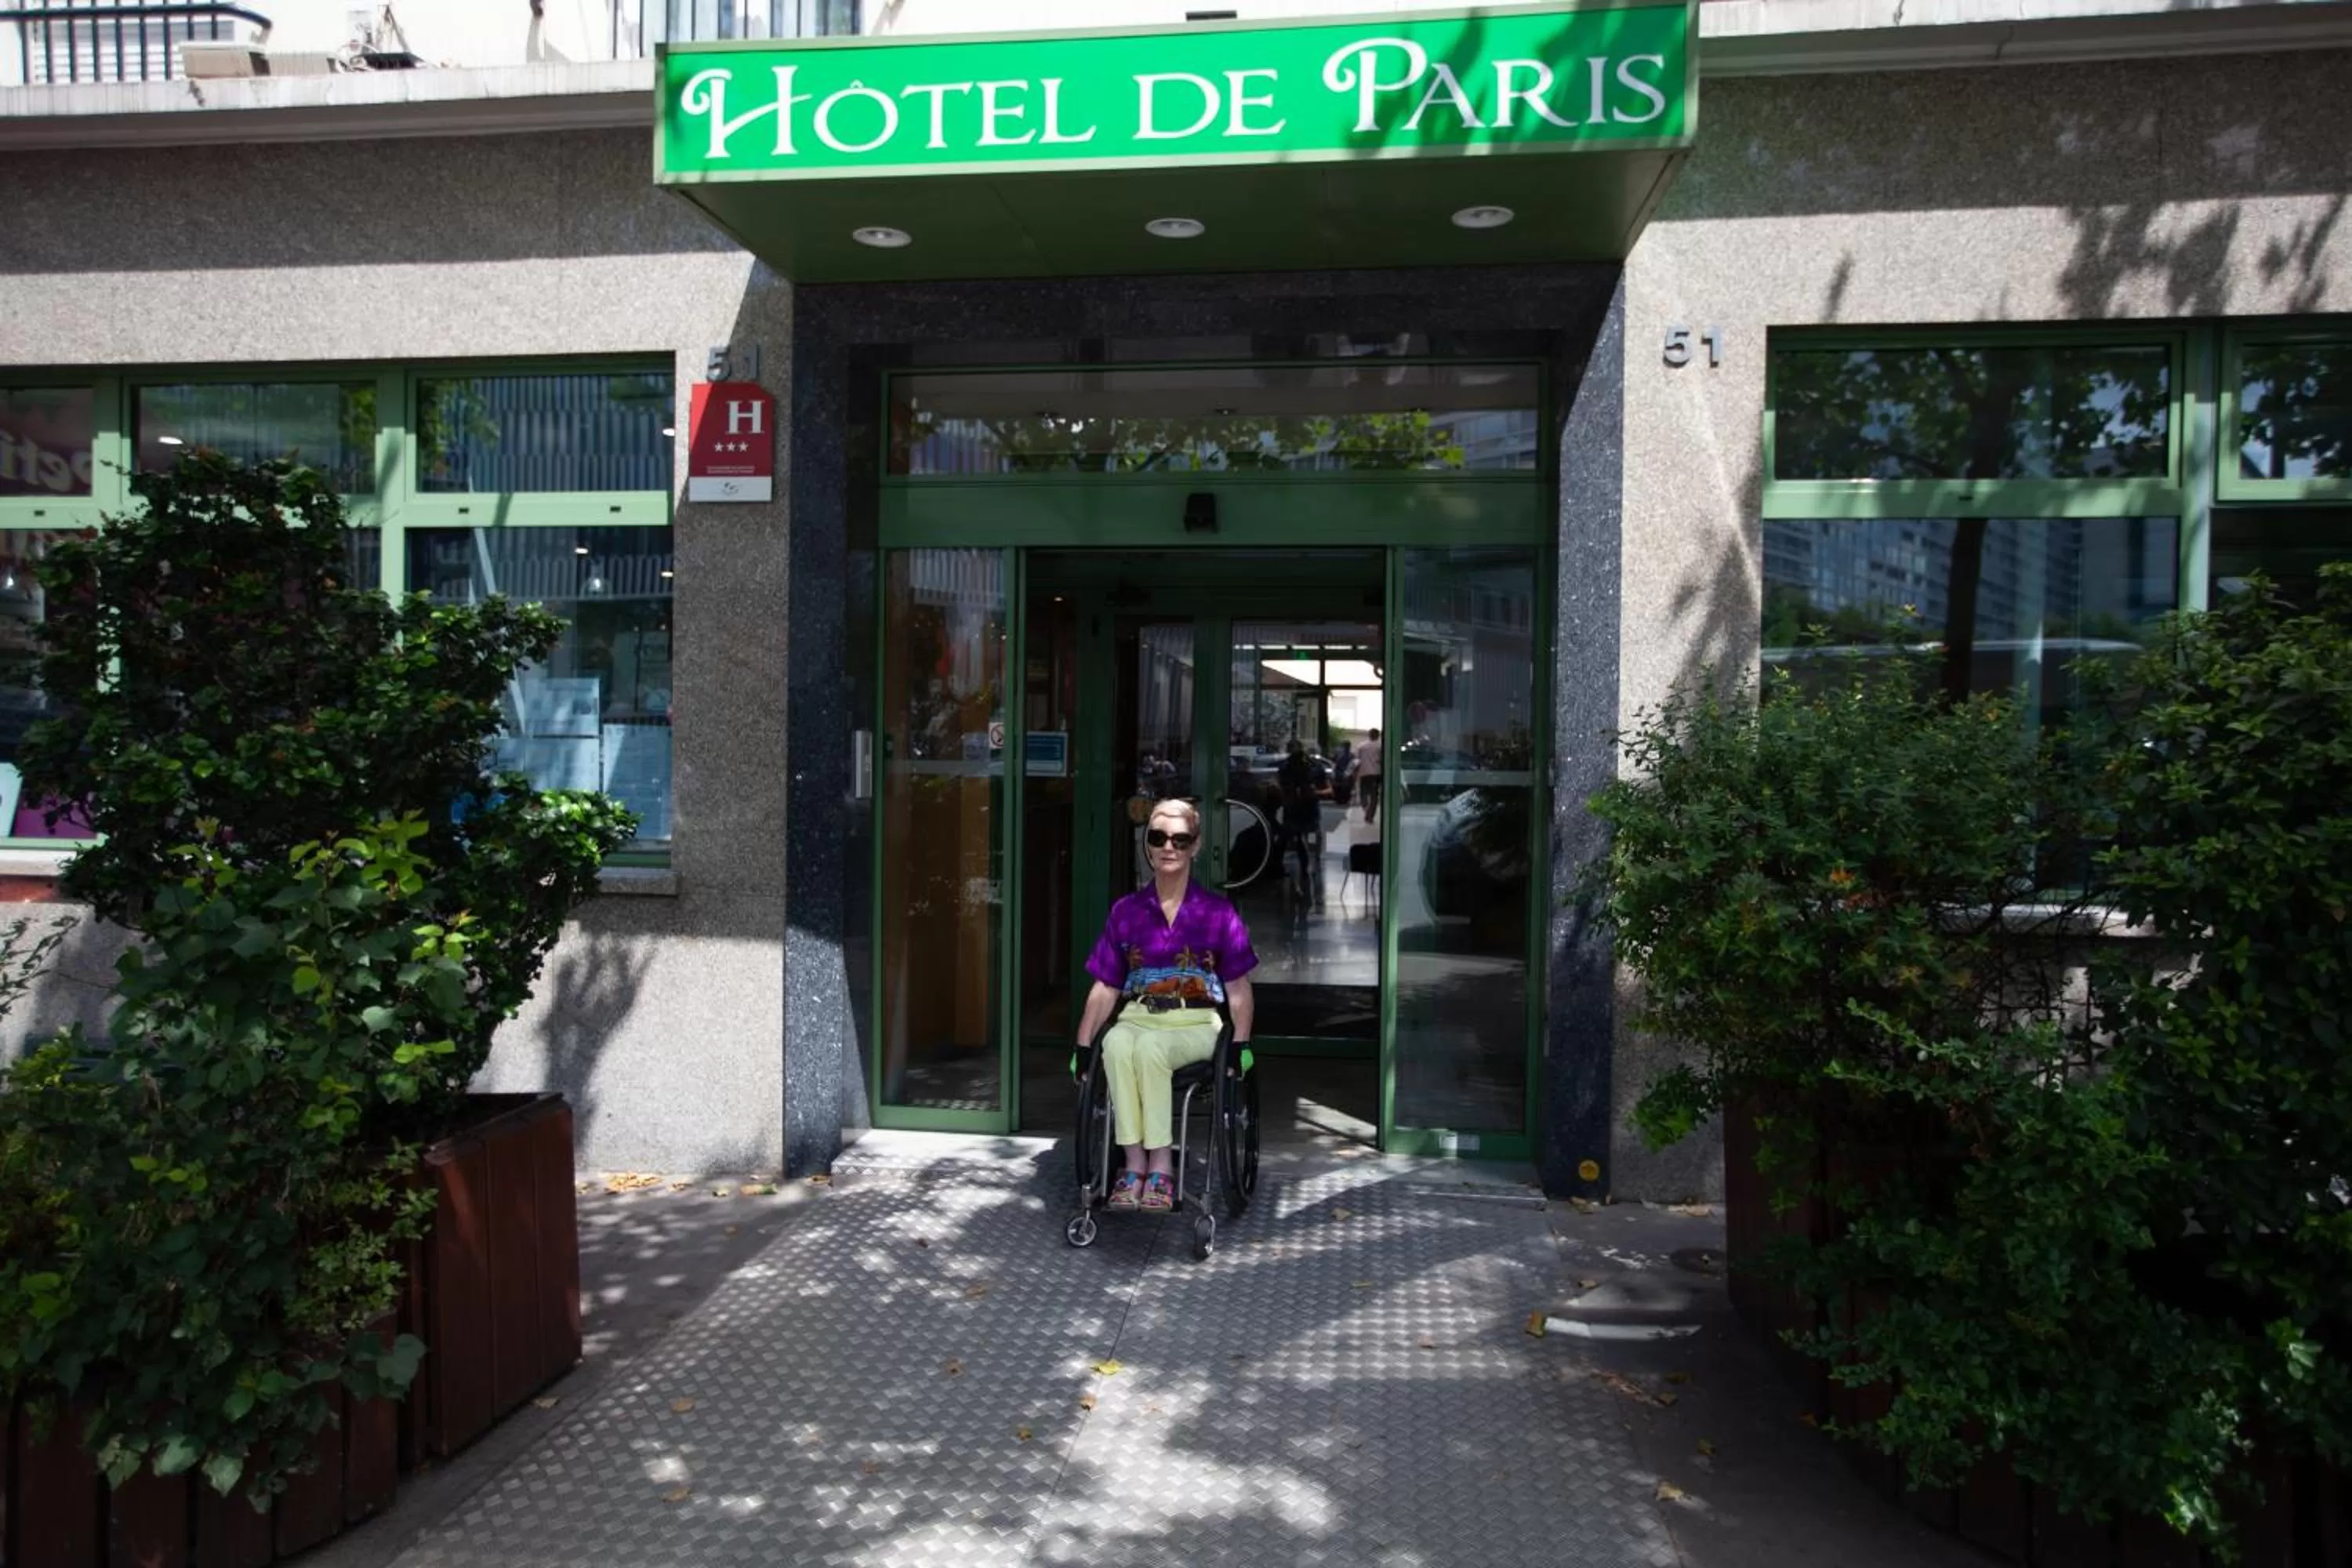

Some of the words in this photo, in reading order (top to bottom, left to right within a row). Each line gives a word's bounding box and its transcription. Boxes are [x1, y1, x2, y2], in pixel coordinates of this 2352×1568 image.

[681, 66, 1095, 158] HÔTEL
[1134, 69, 1285, 136] DE
[1322, 38, 1665, 132] PARIS
[706, 346, 759, 381] 51
[1662, 325, 1722, 368] 51
[725, 400, 764, 434] H
